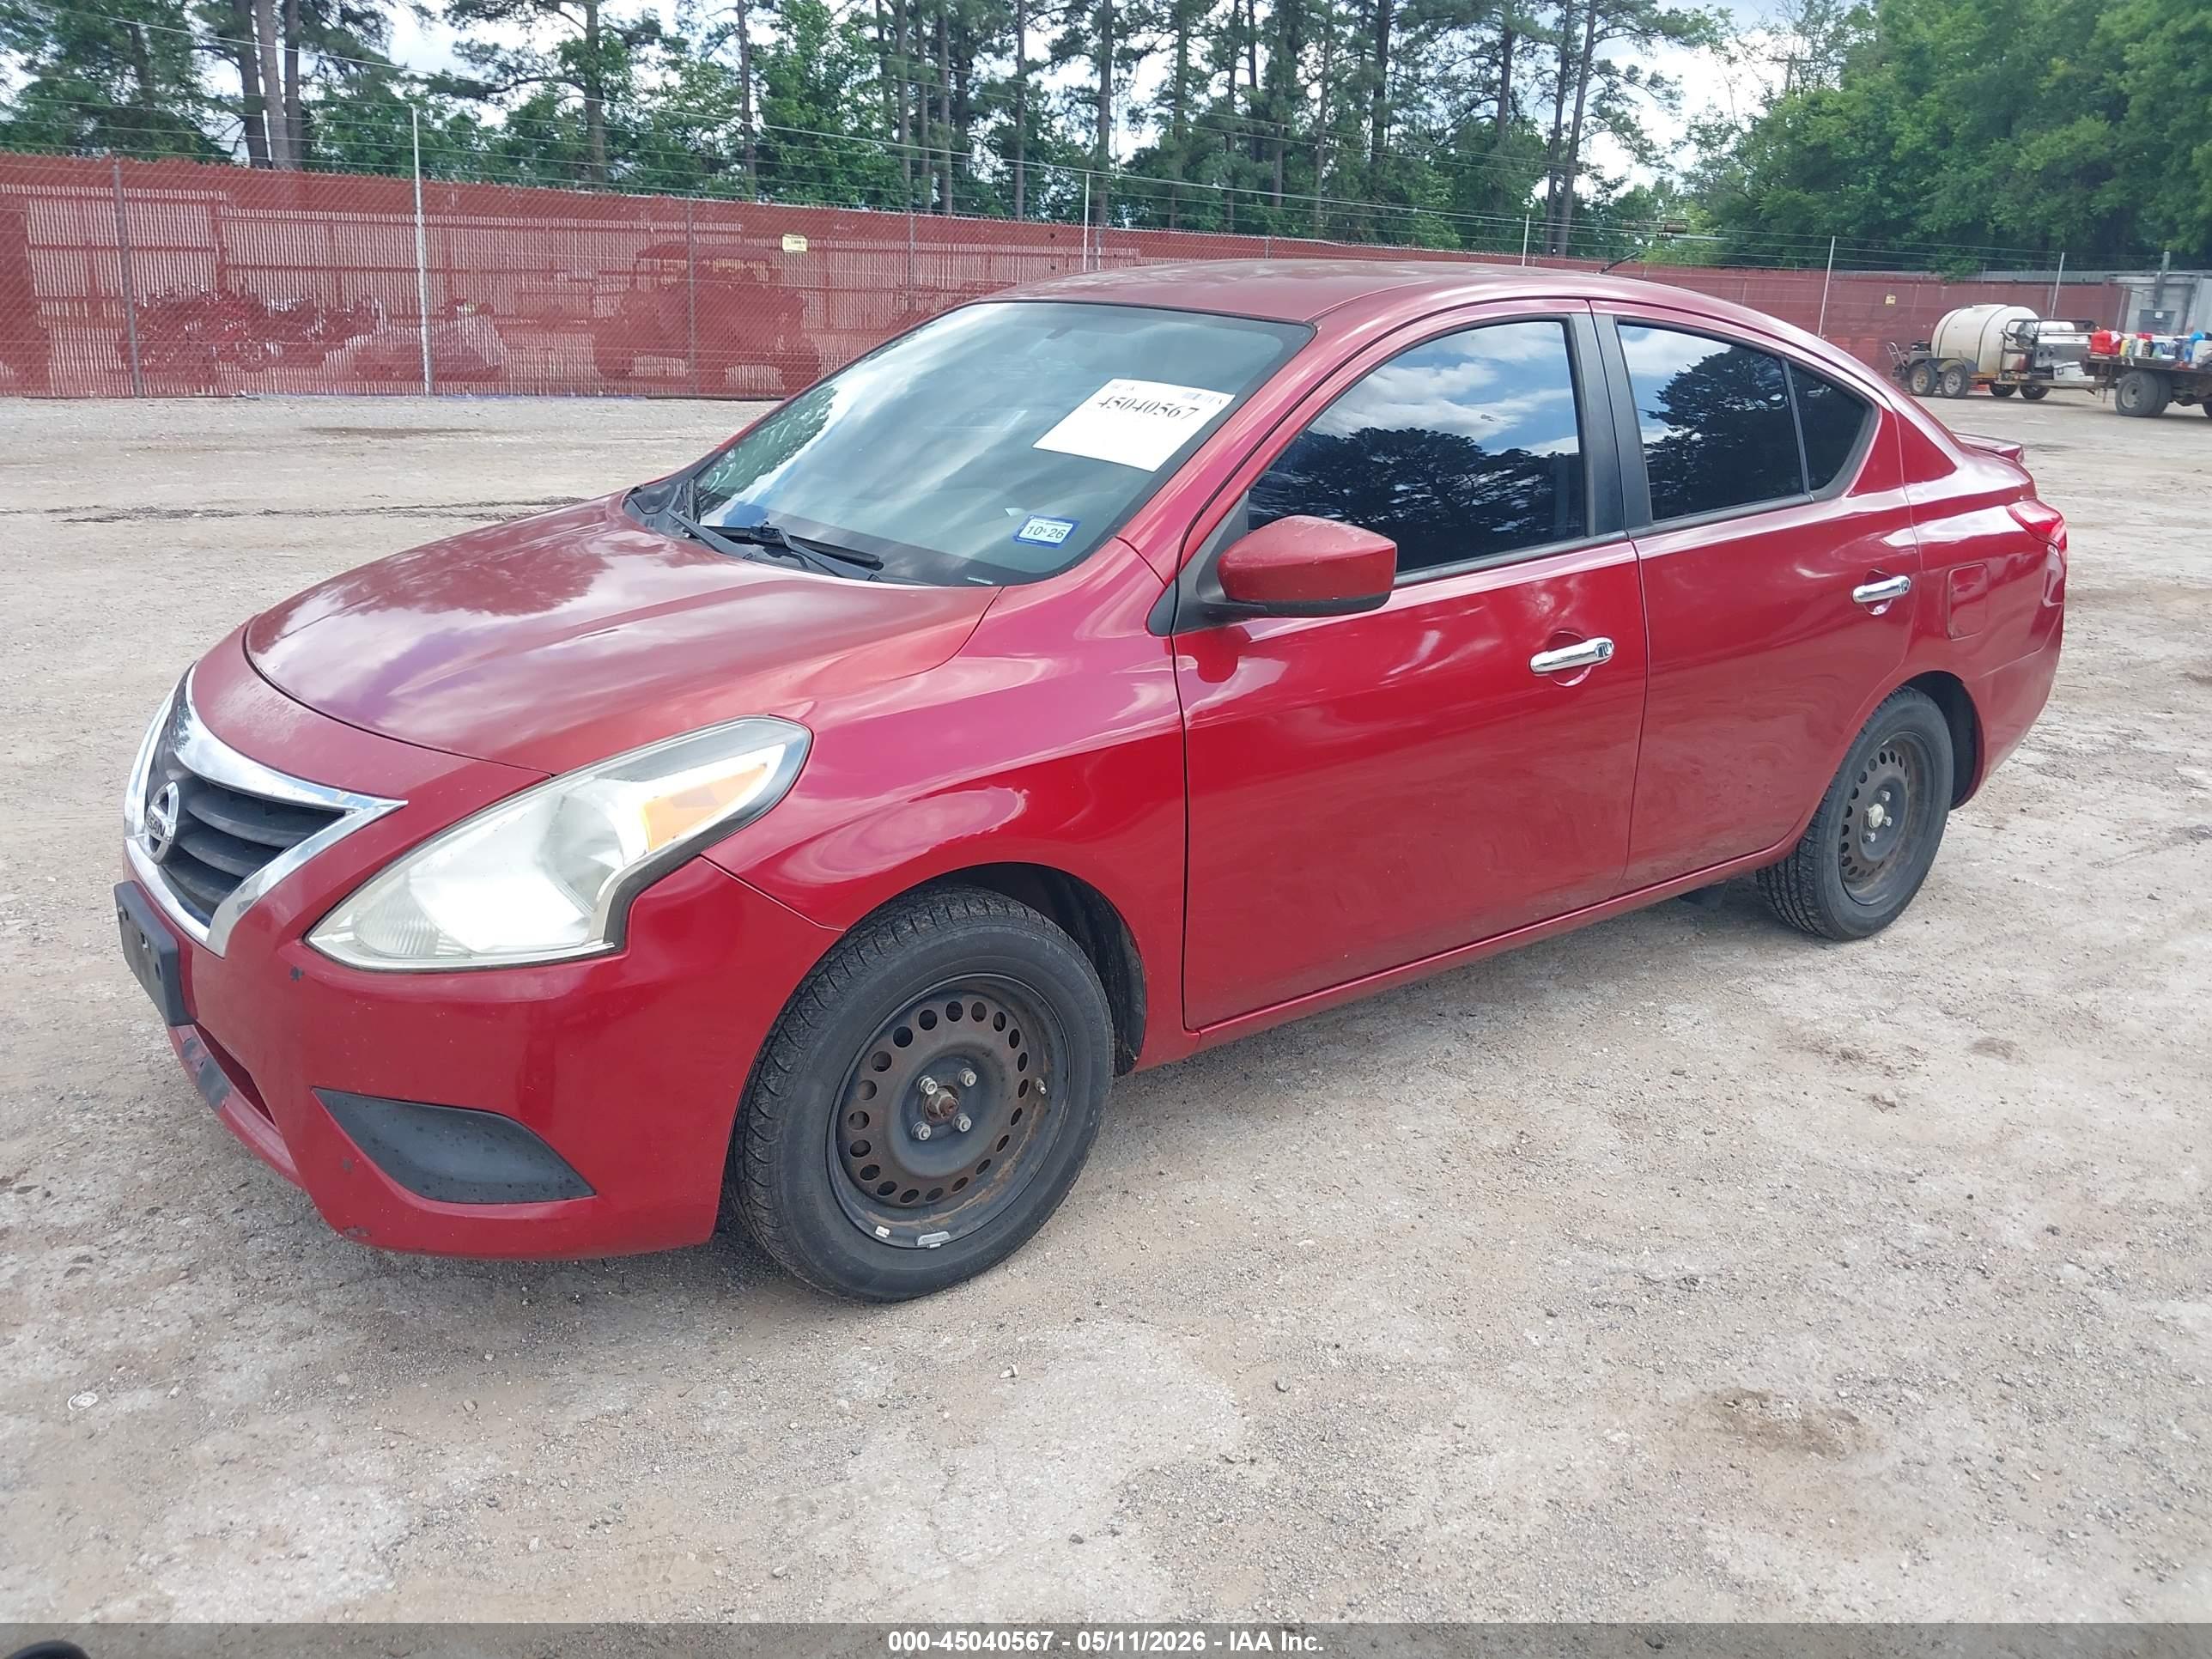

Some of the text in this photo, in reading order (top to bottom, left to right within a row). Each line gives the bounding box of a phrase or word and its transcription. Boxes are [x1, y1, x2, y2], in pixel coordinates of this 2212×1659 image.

[1097, 396, 1200, 420] 45040567
[1026, 525, 1066, 539] 10 26
